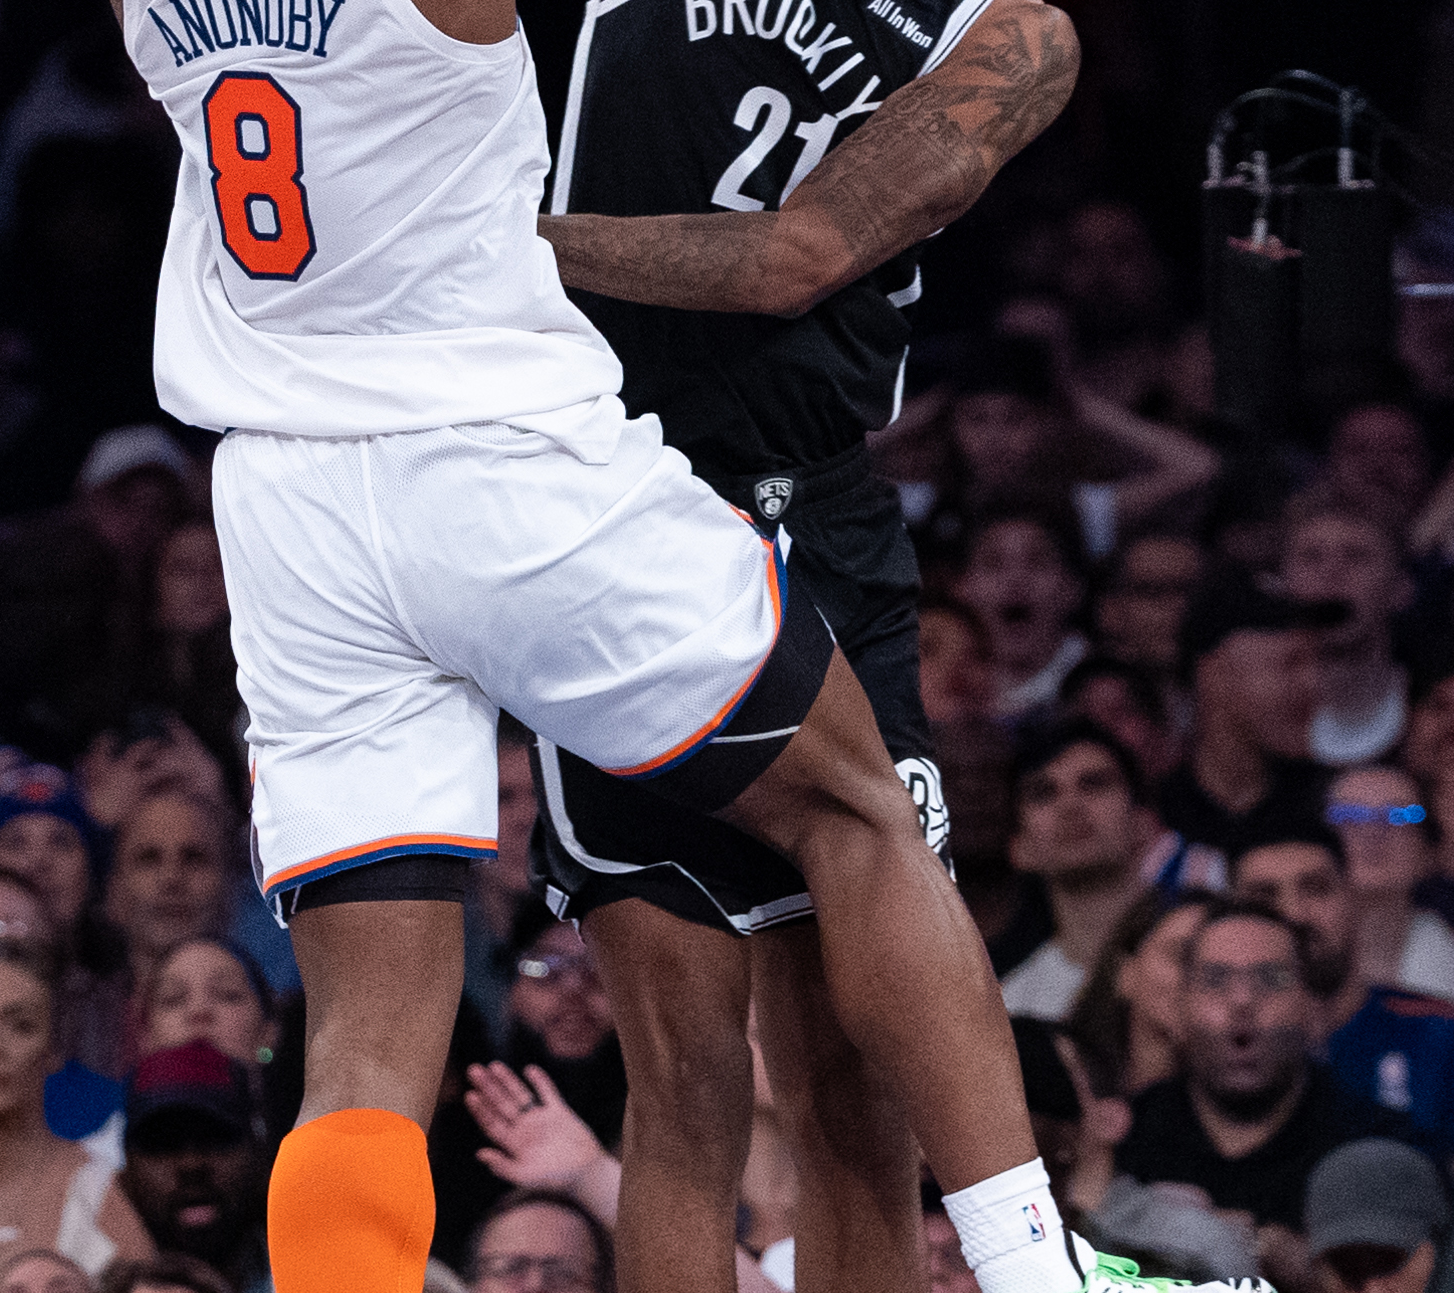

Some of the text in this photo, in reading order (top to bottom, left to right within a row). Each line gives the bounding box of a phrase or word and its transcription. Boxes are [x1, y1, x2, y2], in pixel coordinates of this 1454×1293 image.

[887, 6, 905, 29] In
[901, 17, 933, 48] Won
[202, 71, 317, 282] 8
[711, 85, 840, 212] 21
[759, 481, 790, 501] NETS
